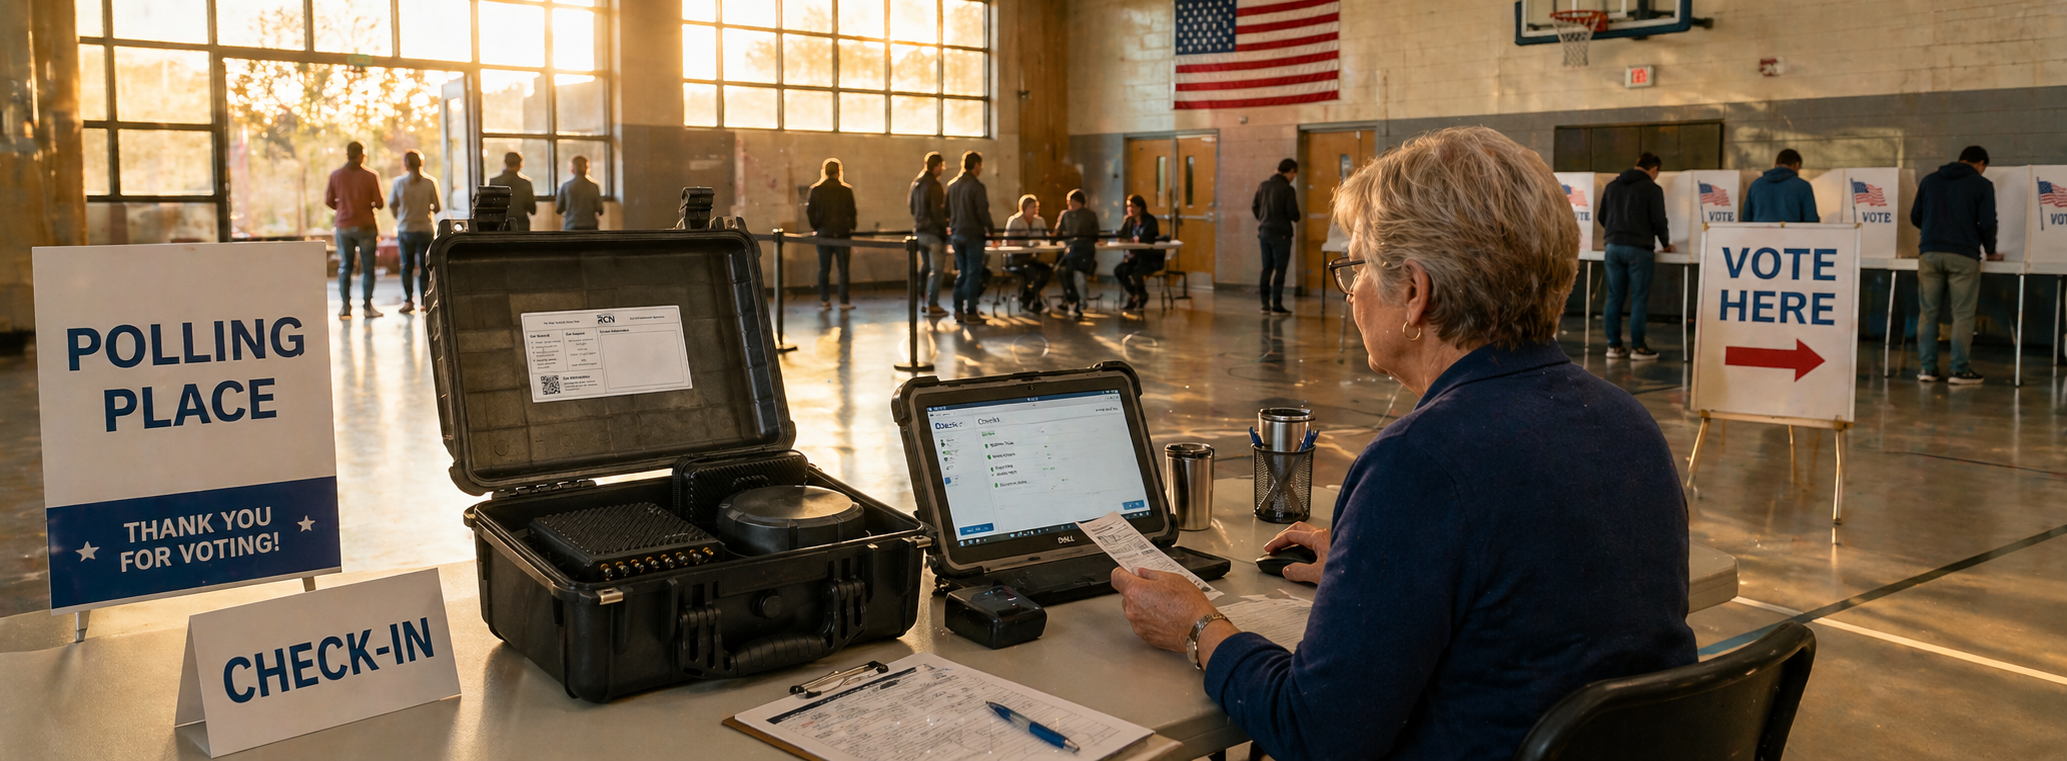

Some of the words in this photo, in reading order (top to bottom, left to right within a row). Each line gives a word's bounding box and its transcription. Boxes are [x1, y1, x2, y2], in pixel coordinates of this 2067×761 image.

[1709, 211, 1734, 221] VOTE
[1862, 212, 1891, 223] VOTE
[1722, 247, 1837, 281] VOTE
[597, 315, 616, 325] RCN
[1720, 290, 1835, 325] HERE
[67, 317, 305, 371] POLLING
[104, 378, 277, 432] PLACE
[124, 513, 214, 543] THANK
[220, 506, 272, 531] YOU
[120, 548, 172, 573] FOR
[178, 531, 280, 564] VOTING!
[223, 617, 435, 703] CHECK-IN
